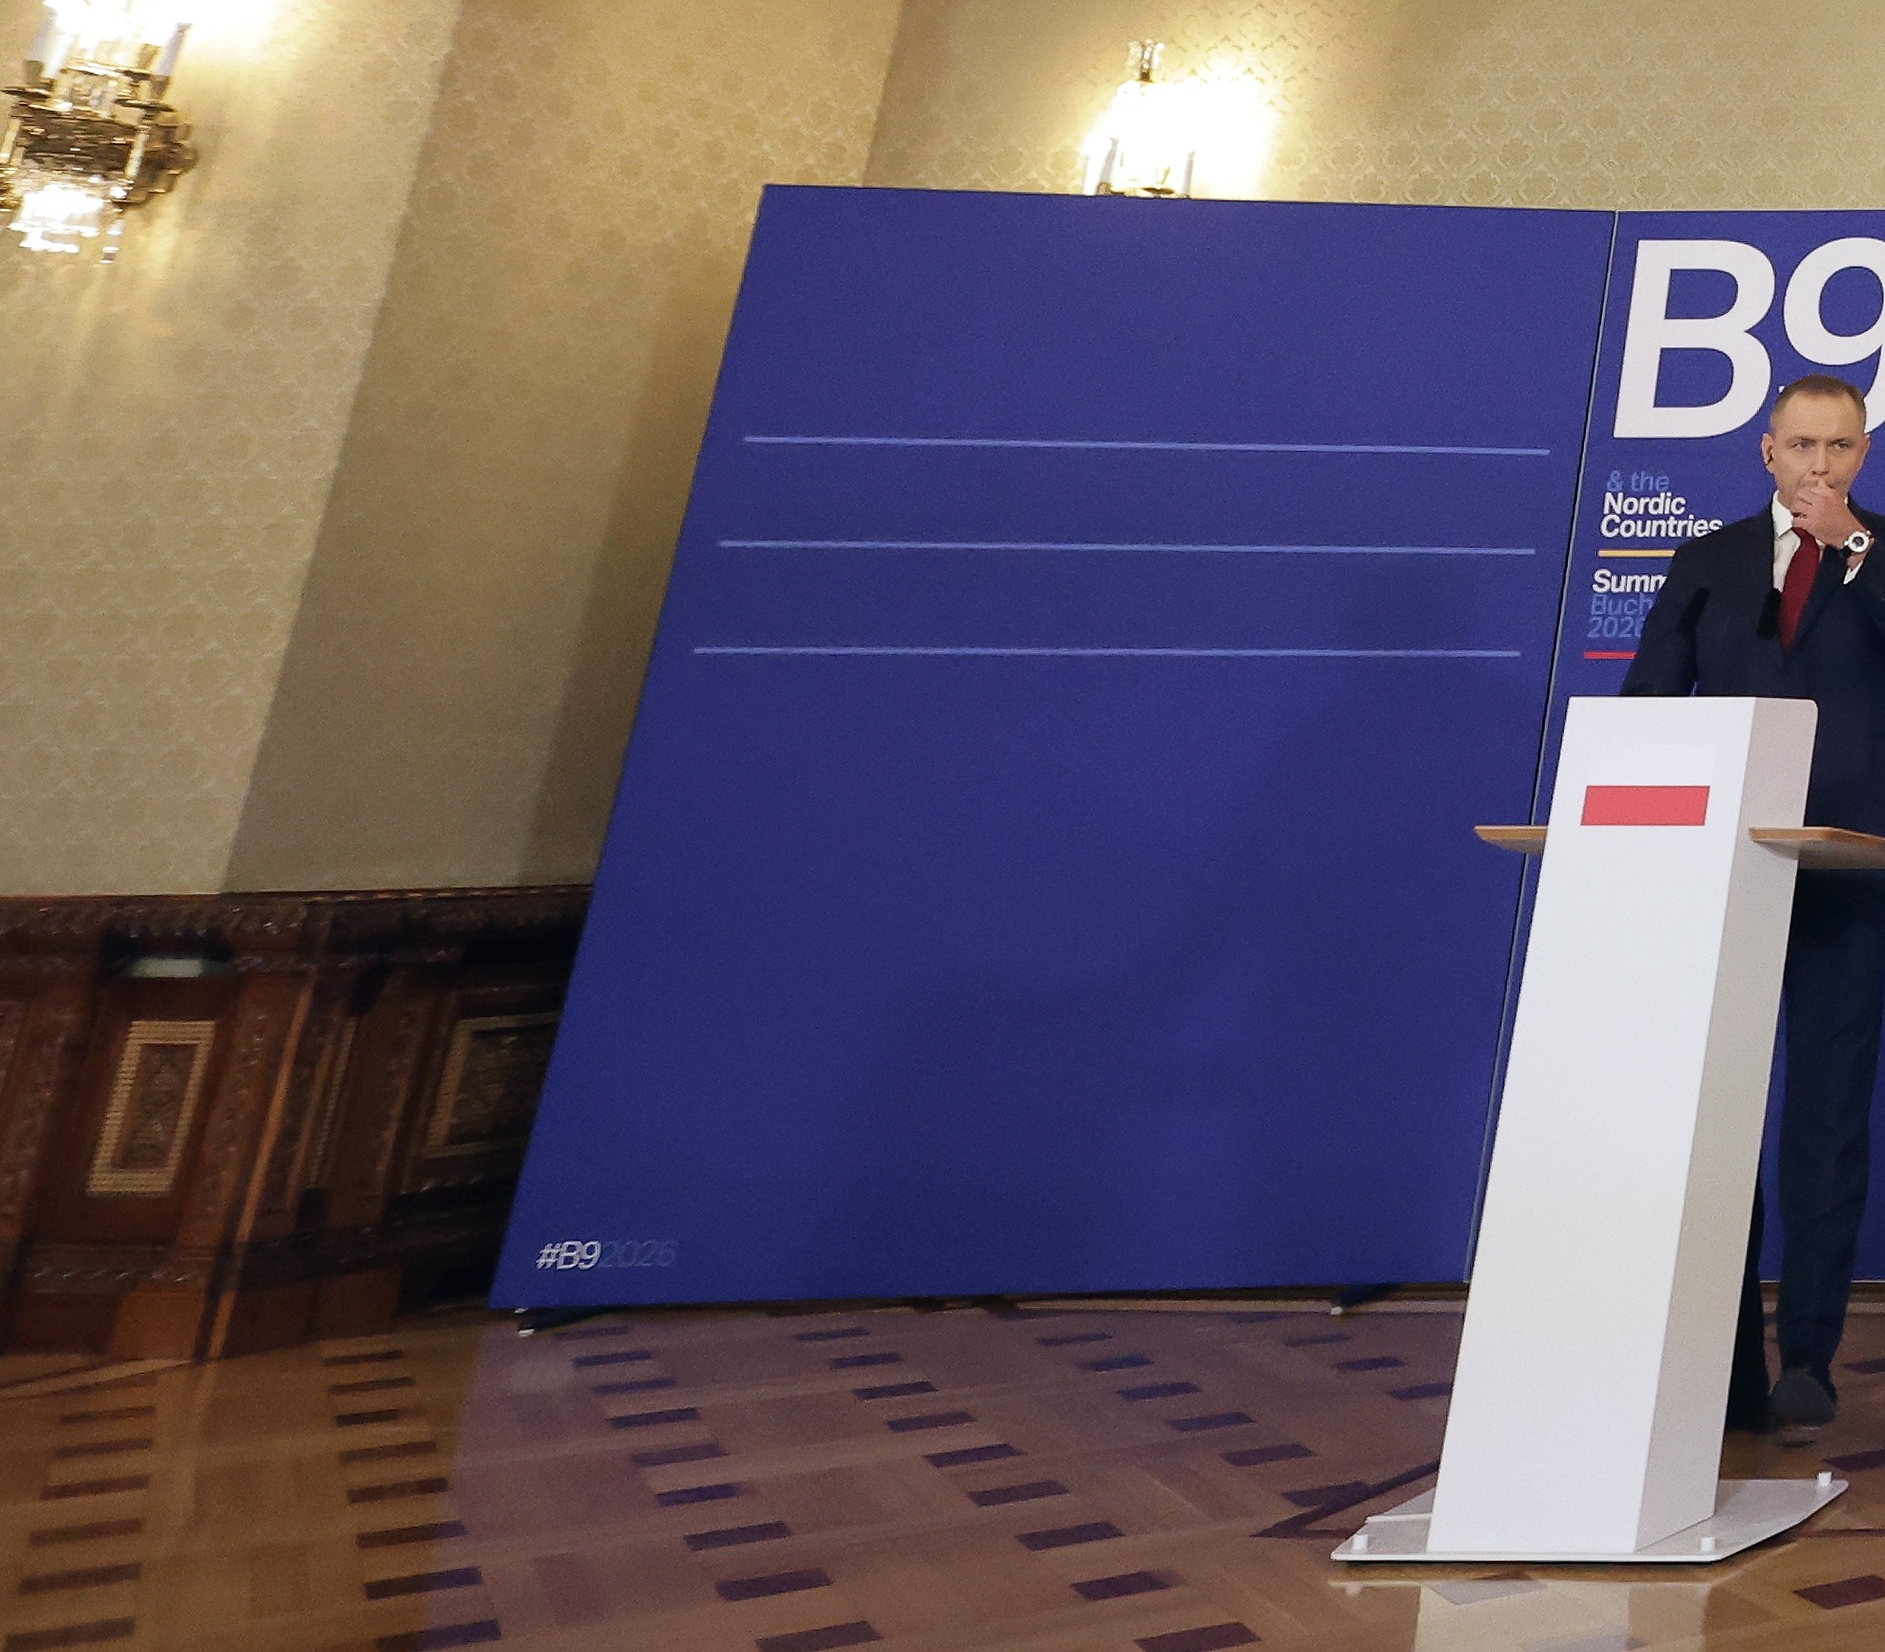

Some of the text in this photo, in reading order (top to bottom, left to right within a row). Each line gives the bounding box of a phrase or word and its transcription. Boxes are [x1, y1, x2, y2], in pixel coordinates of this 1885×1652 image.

[1606, 470, 1670, 491] & the
[1603, 492, 1686, 515] Nordic
[1601, 514, 1724, 538] Countries
